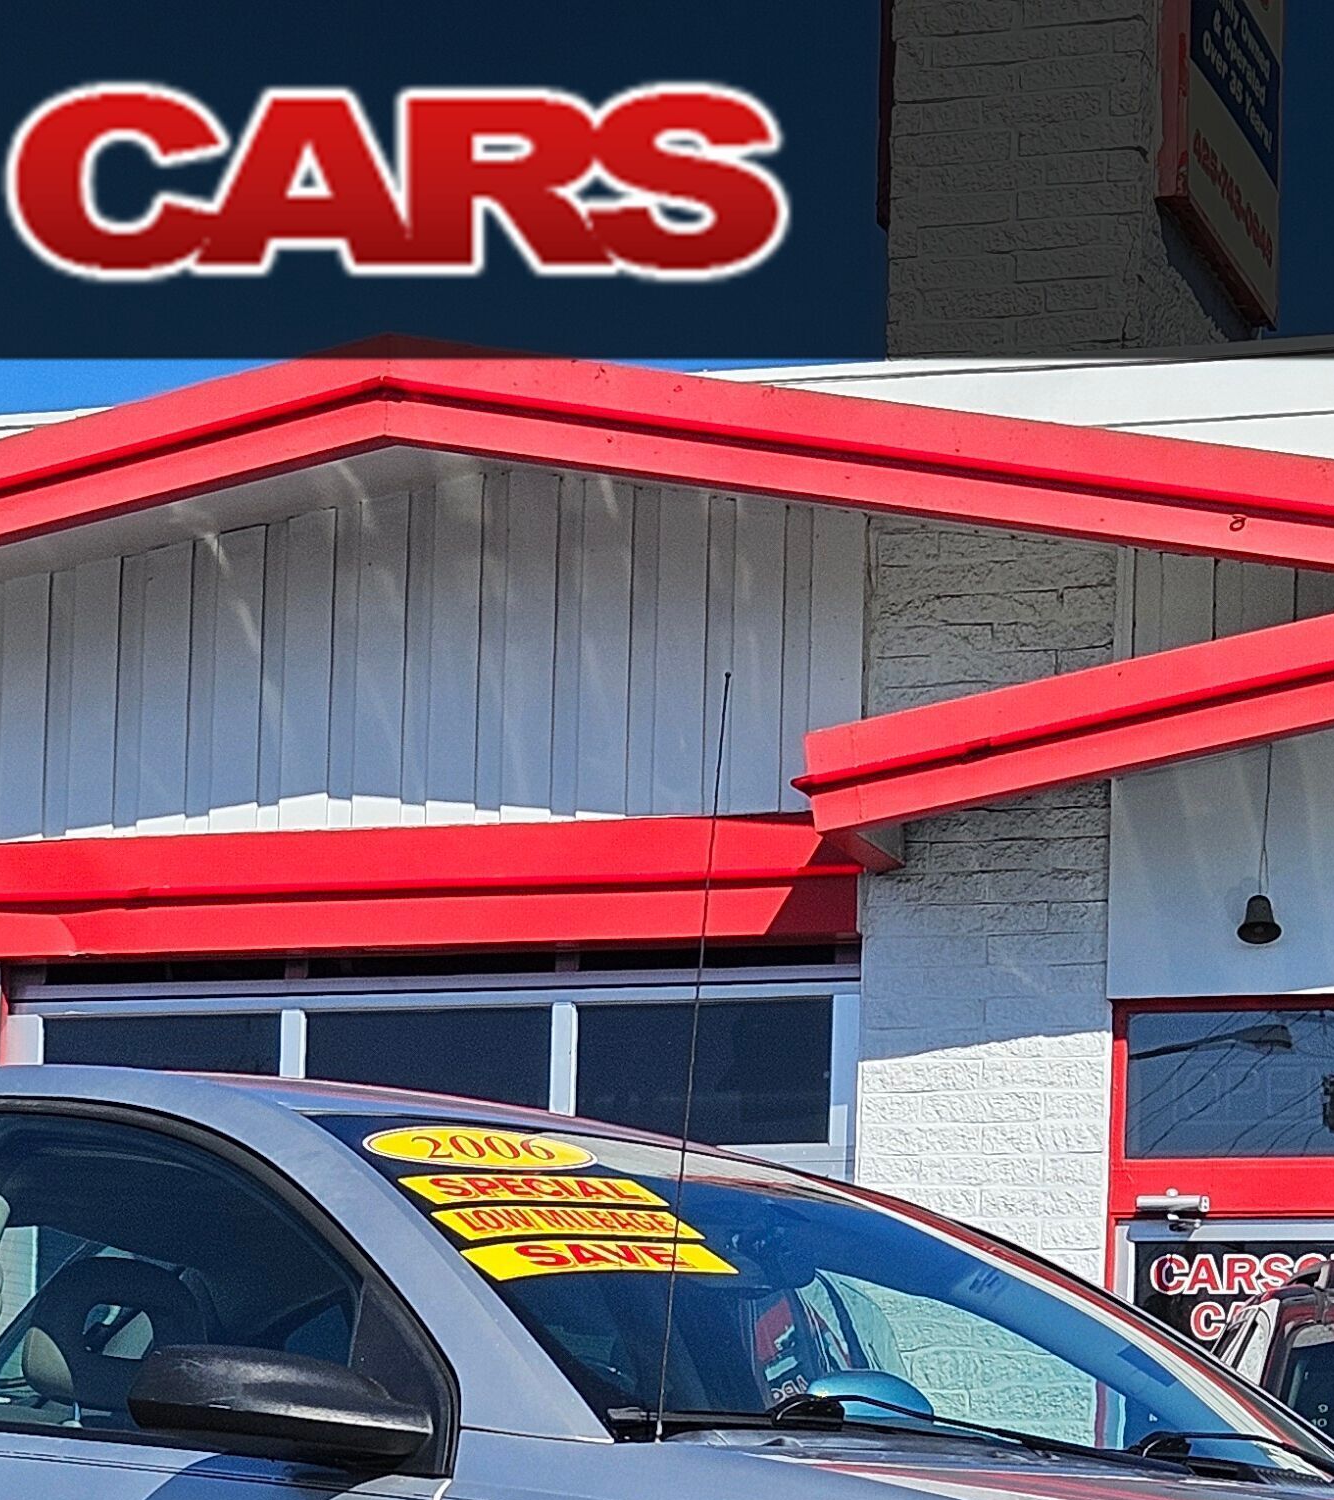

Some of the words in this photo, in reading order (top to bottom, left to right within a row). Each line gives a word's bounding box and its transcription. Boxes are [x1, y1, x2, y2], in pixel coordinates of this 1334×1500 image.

[1202, 29, 1228, 79] Over
[411, 1134, 555, 1160] 2006
[427, 1176, 640, 1200] SPECIAL
[456, 1209, 535, 1232] LOW
[545, 1208, 679, 1233] MILEAGE
[514, 1243, 685, 1267] SAVE
